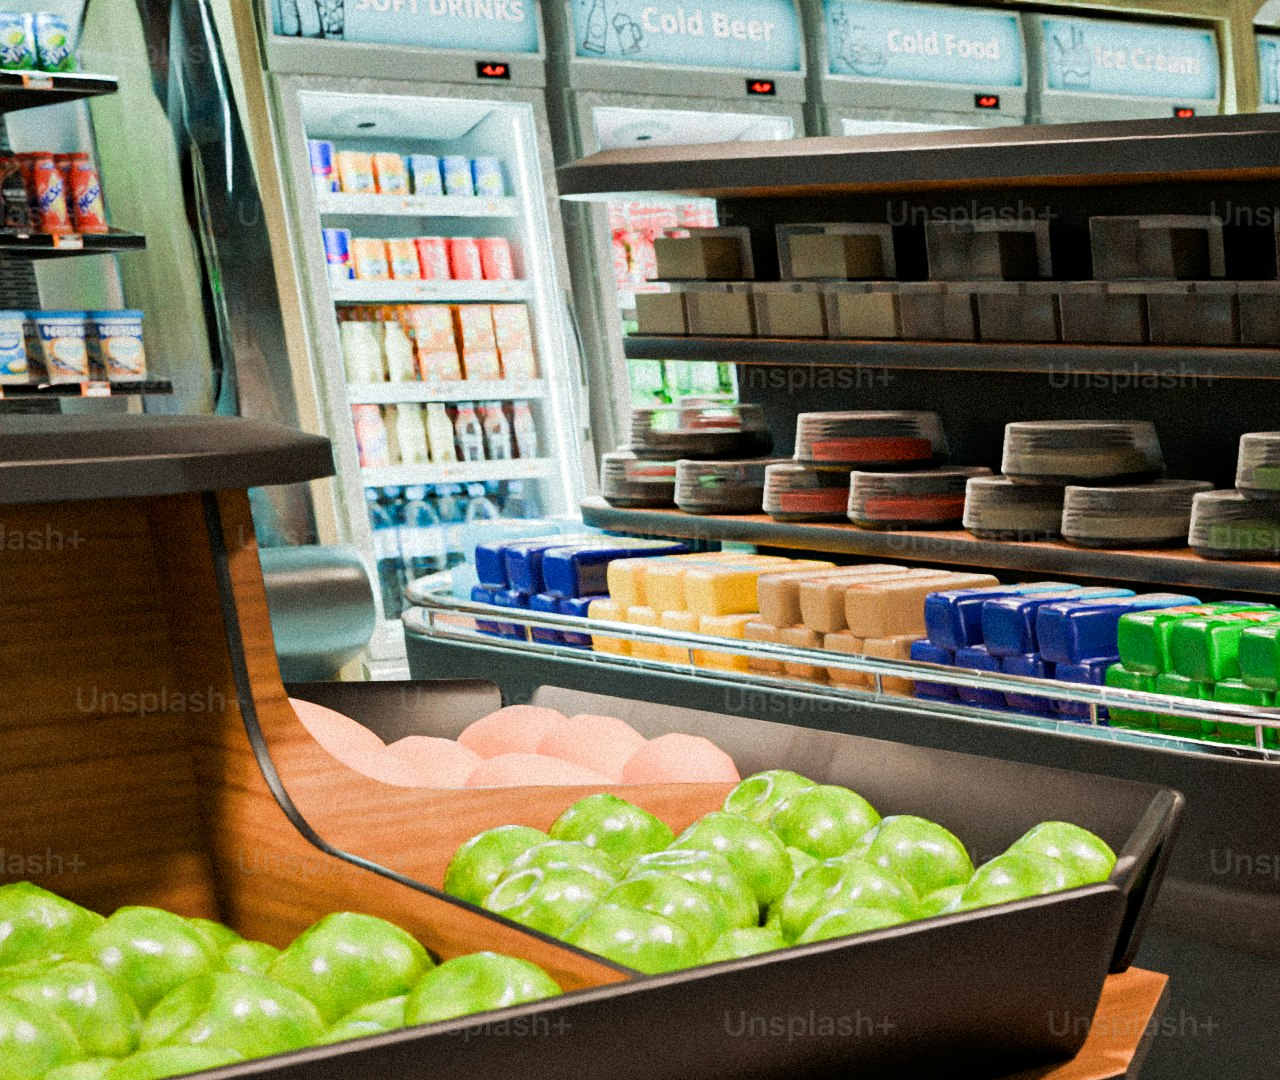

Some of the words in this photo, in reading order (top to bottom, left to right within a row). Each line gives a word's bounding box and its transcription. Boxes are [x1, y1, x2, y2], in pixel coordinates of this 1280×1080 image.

[429, 0, 526, 23] DRINKS
[641, 7, 704, 36] Cold
[711, 12, 776, 41] Beer
[886, 29, 939, 54] Cold
[945, 35, 1001, 60] Food
[1094, 47, 1125, 69] Ice
[1131, 48, 1201, 75] Cream
